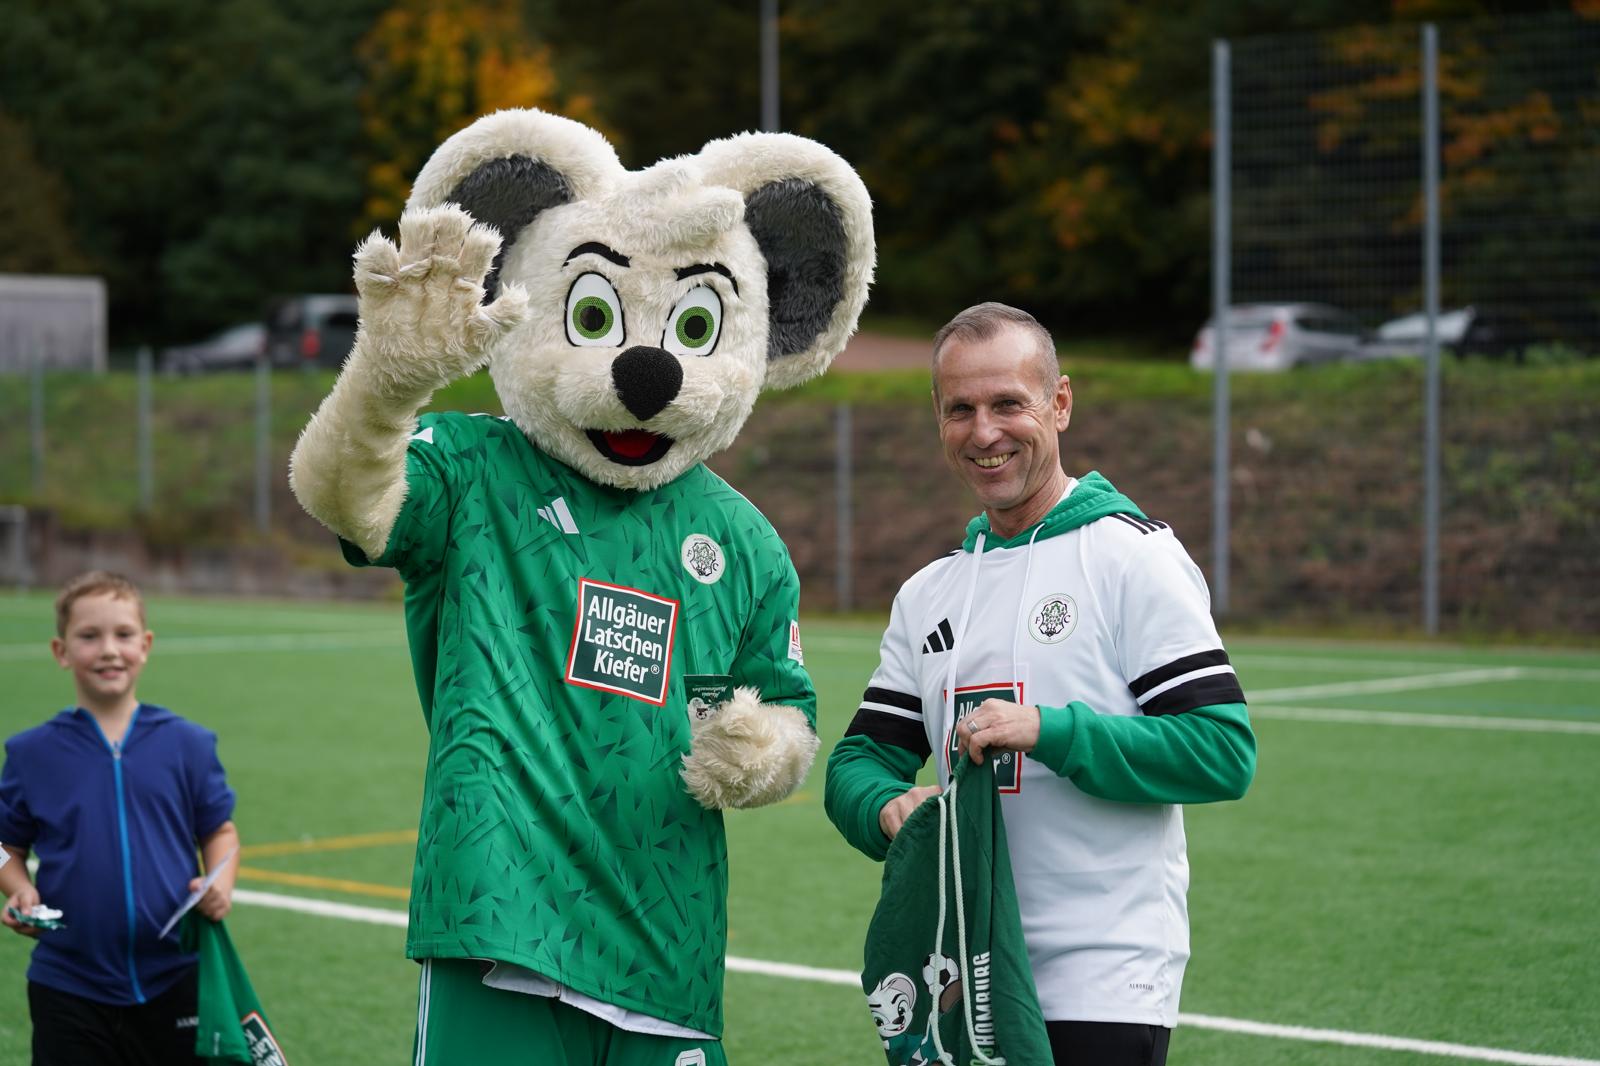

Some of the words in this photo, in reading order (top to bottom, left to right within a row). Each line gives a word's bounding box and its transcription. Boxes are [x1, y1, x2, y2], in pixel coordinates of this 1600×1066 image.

[587, 594, 666, 636] Allgäuer
[1063, 614, 1071, 624] C
[583, 618, 663, 662] Latschen
[972, 951, 995, 1046] HOMBURG
